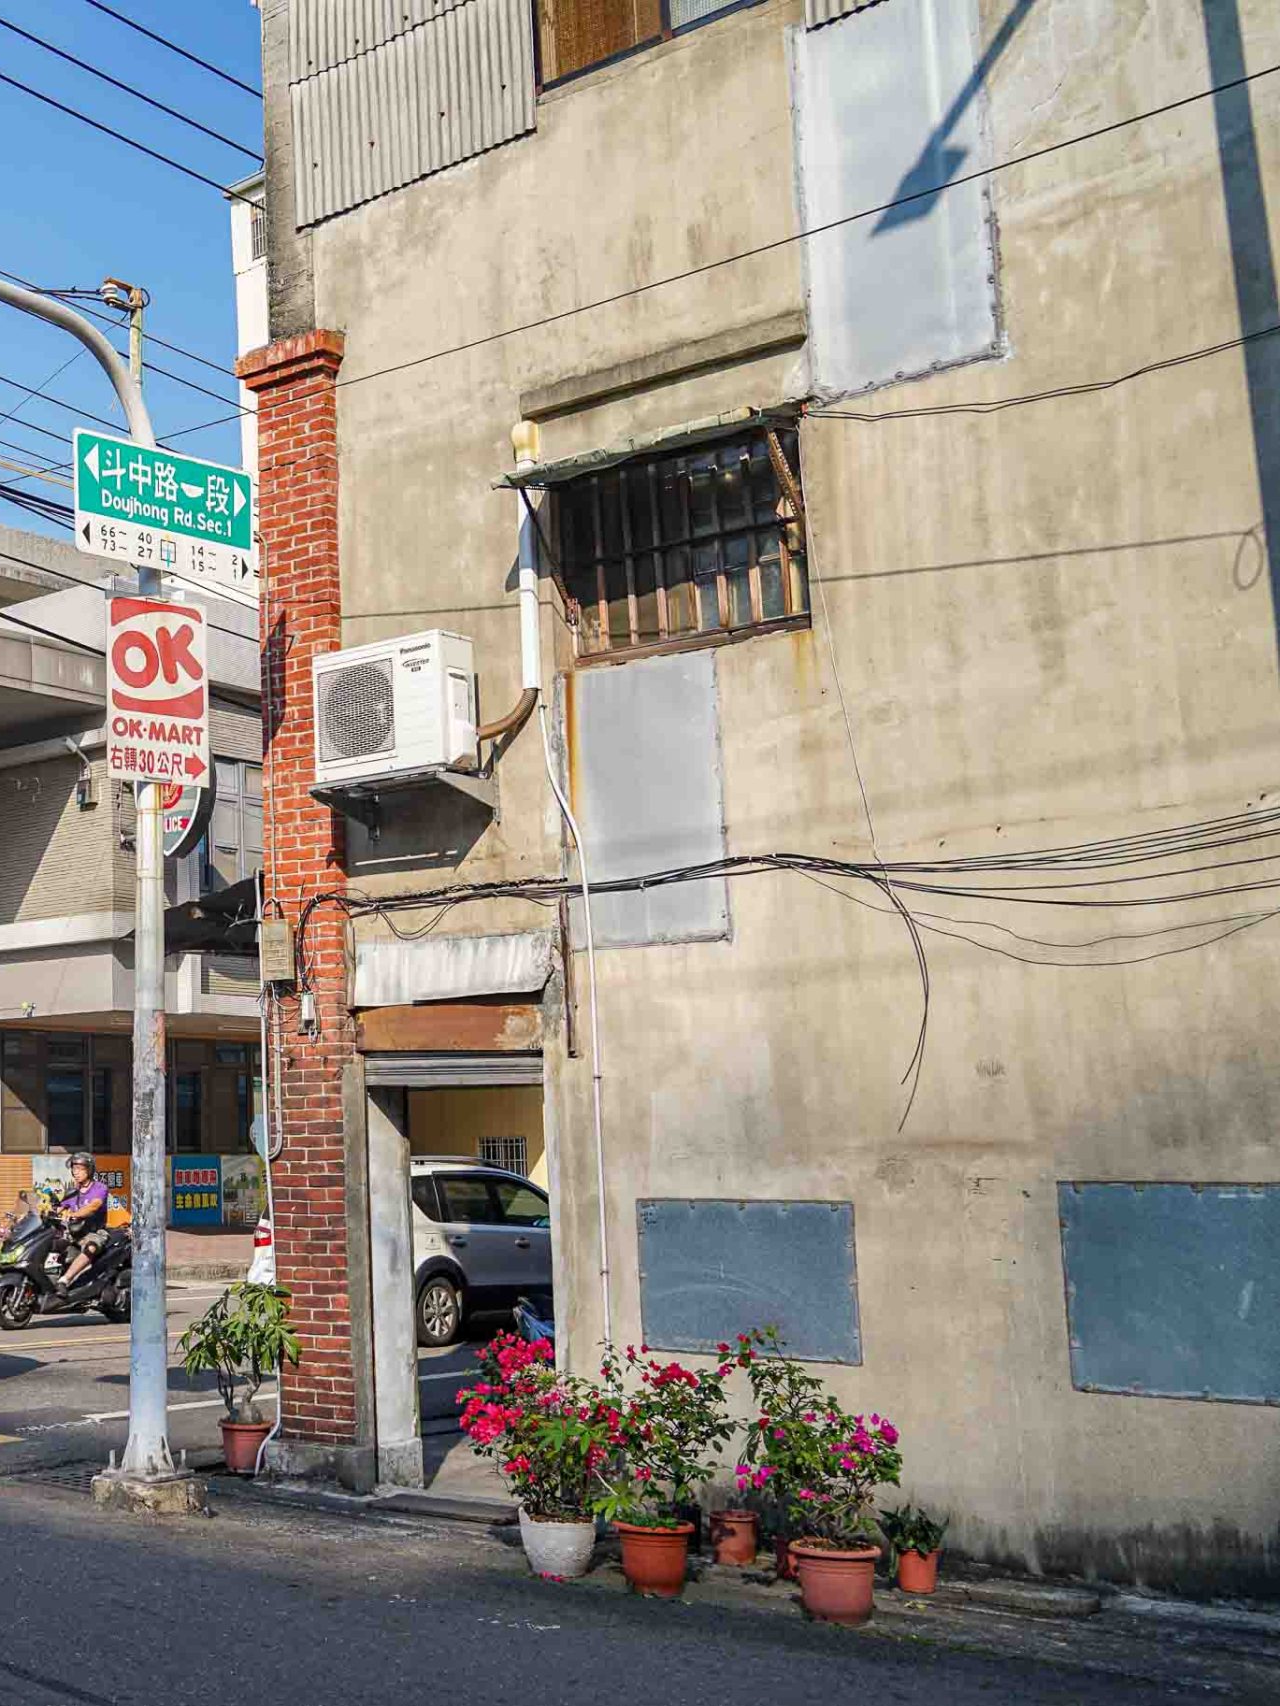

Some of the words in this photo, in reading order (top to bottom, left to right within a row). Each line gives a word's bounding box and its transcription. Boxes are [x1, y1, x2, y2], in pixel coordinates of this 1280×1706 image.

[101, 448, 231, 515] 斗中路一段
[101, 490, 169, 526] Doujhong
[138, 532, 152, 544] 40
[138, 546, 152, 559] 27
[231, 554, 238, 566] 2
[111, 623, 204, 689] OK
[110, 746, 184, 777] 右轉30公尺
[164, 816, 183, 833] LICE
